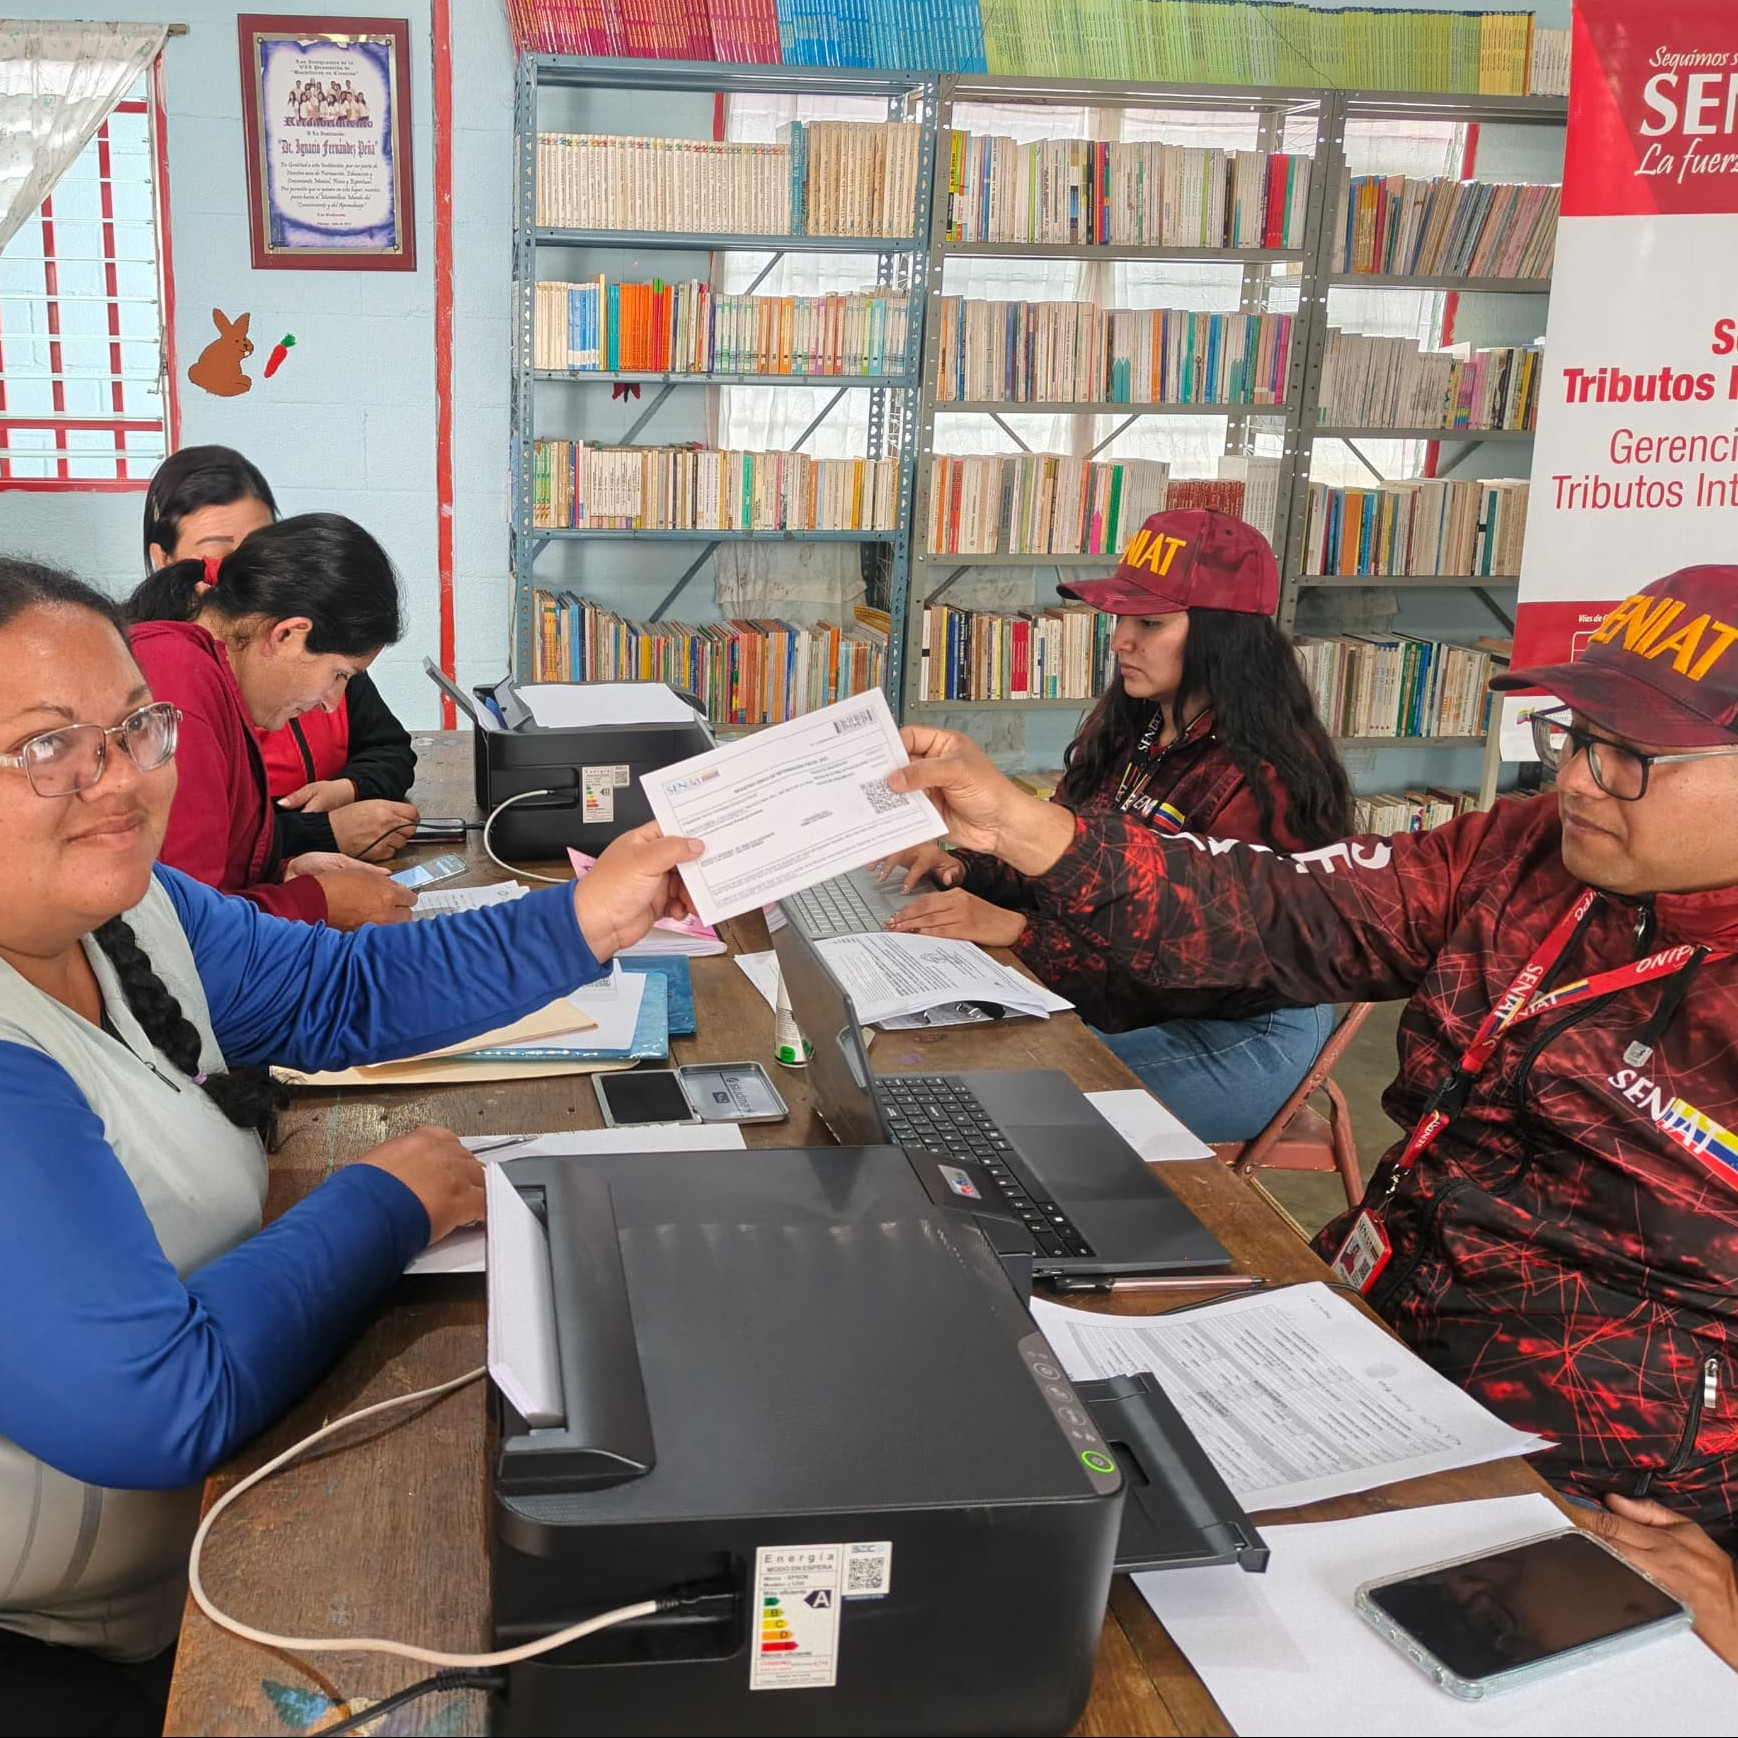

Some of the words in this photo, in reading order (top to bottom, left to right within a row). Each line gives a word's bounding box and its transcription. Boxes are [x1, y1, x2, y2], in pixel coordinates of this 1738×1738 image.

[1649, 46, 1727, 76] Seguimos
[295, 139, 321, 157] Ignacio
[1634, 142, 1673, 176] La
[1562, 366, 1716, 403] Tributos
[1552, 474, 1684, 510] Tributos
[1493, 962, 1545, 1019] SENIAT
[1607, 1068, 1727, 1155] SENIAT
[812, 1591, 830, 1608] A
